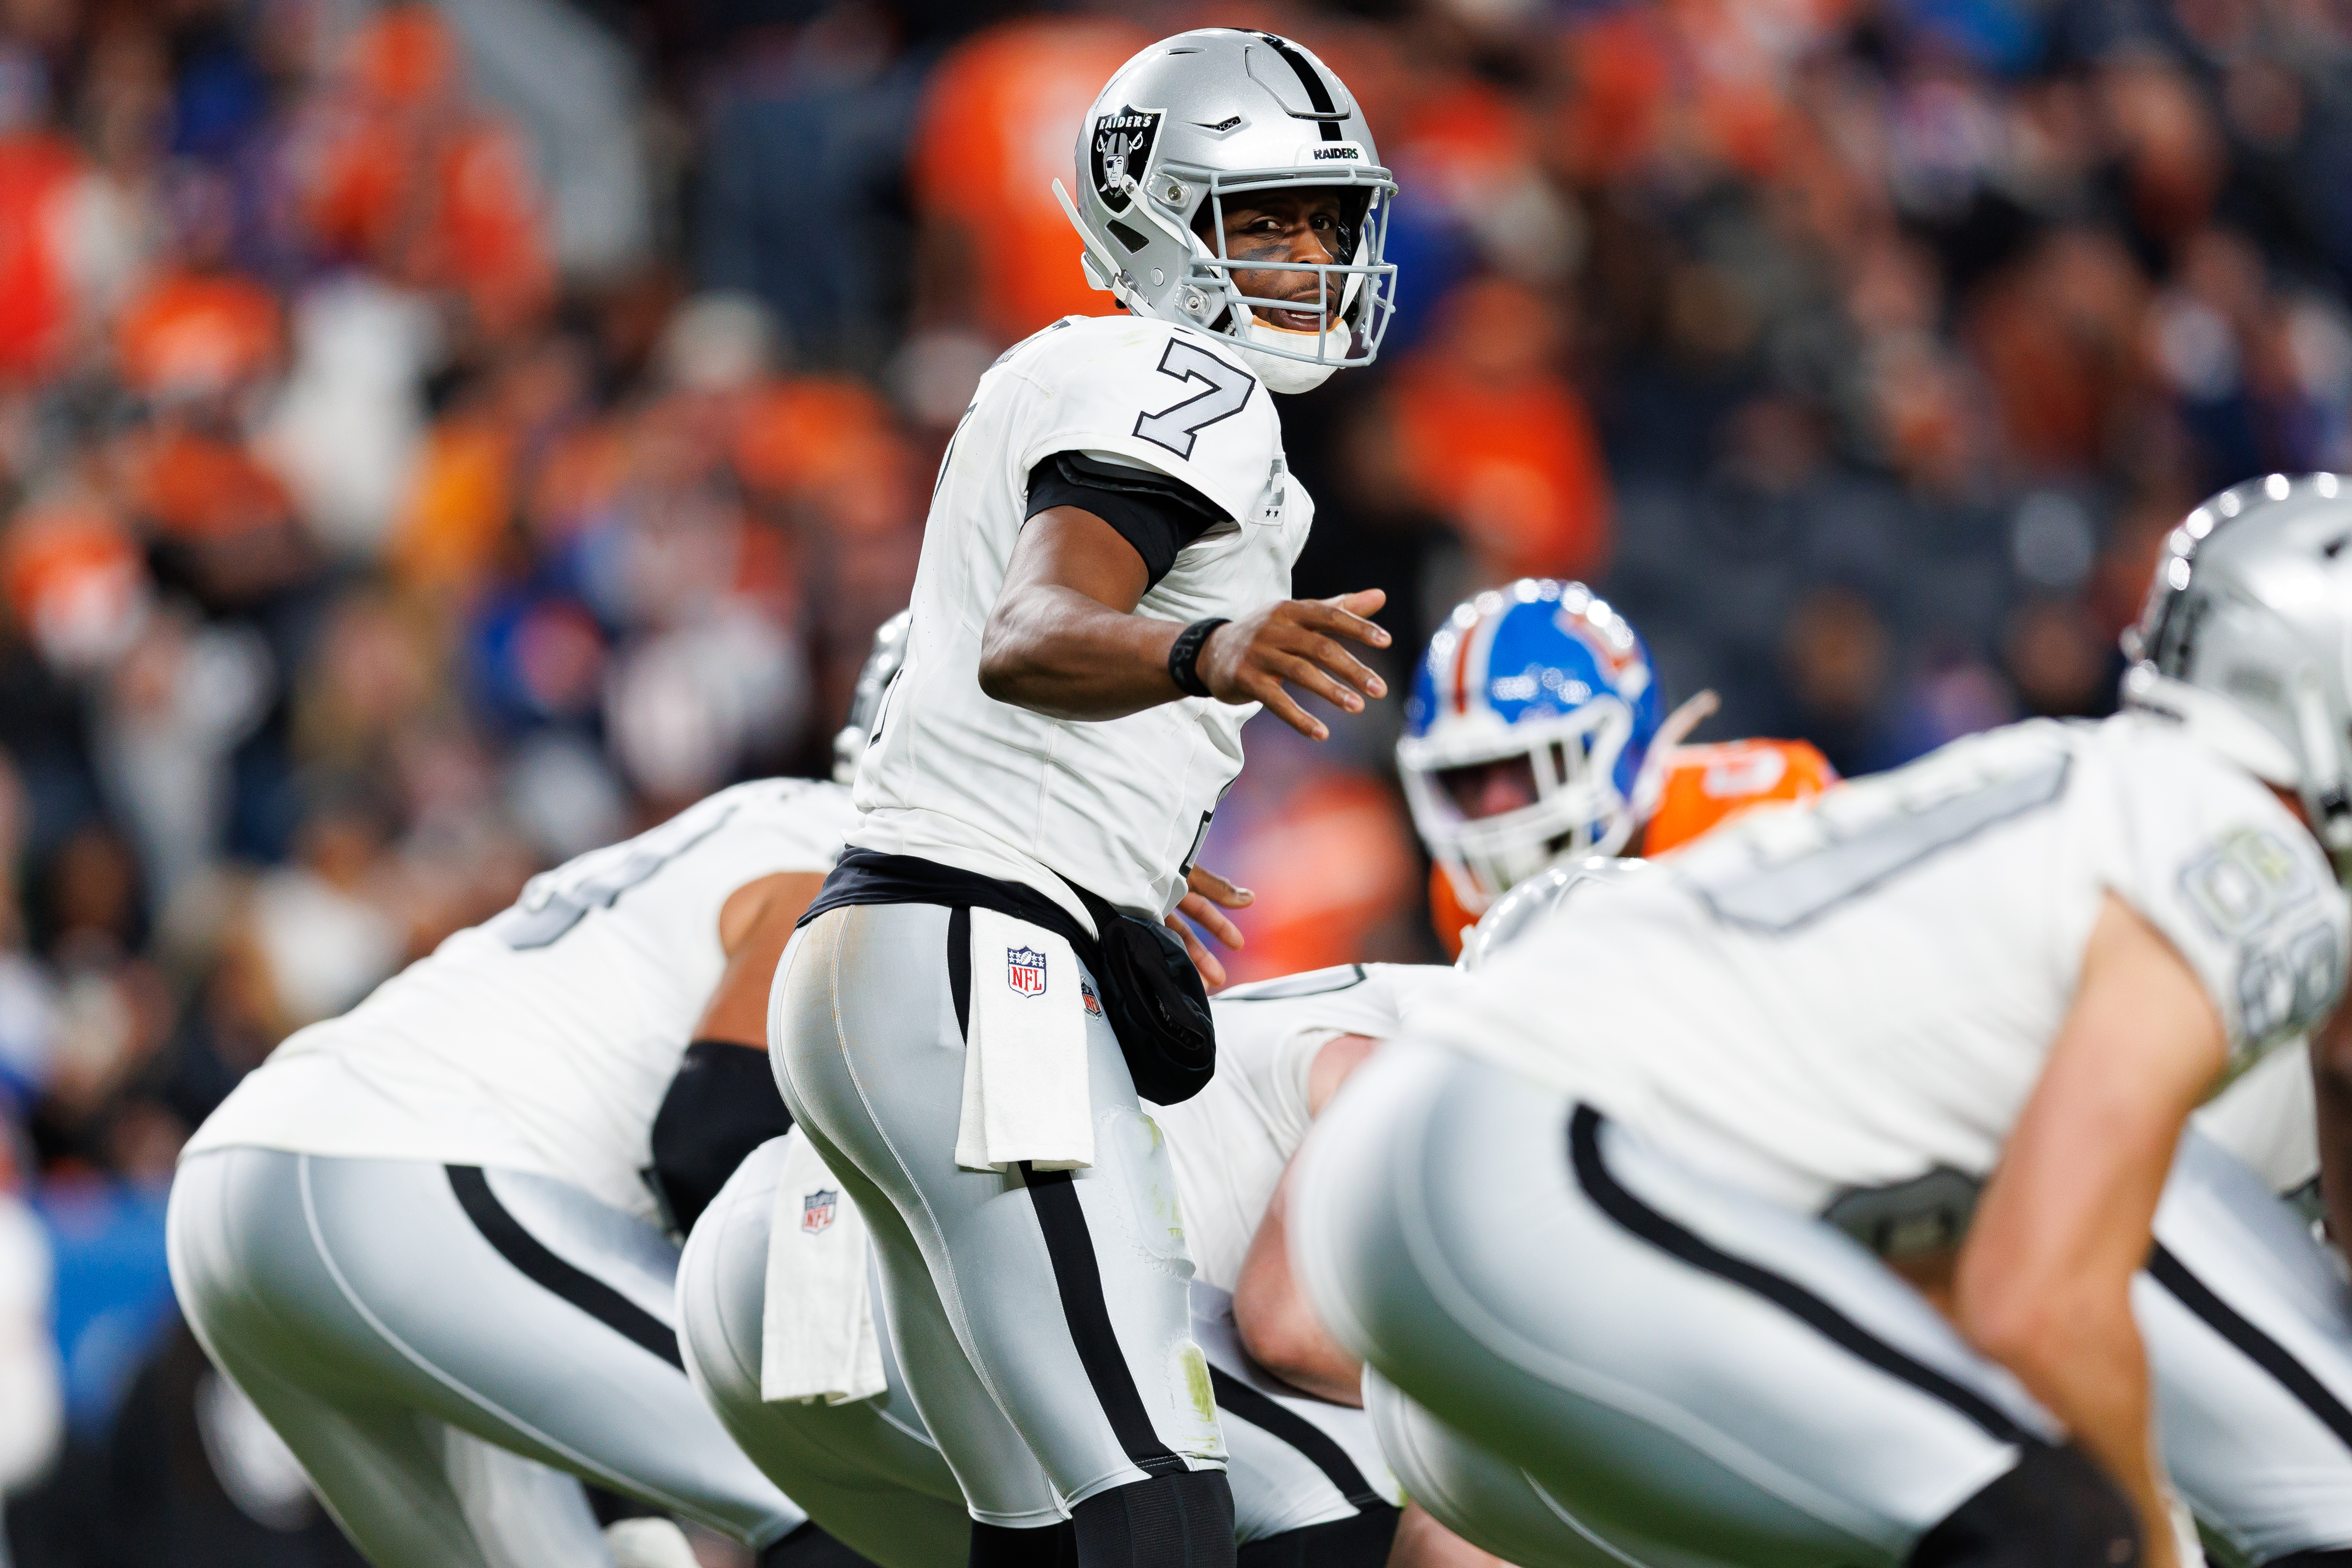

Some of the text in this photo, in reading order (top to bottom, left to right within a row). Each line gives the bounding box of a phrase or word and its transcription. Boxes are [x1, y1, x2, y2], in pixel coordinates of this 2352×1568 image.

[1098, 116, 1153, 130] RAIDERS
[1313, 148, 1359, 160] RAIDERS
[1131, 336, 1256, 462] 7
[1012, 966, 1042, 992] NFL
[1083, 993, 1101, 1012] NFL
[805, 1206, 831, 1228] NFL
